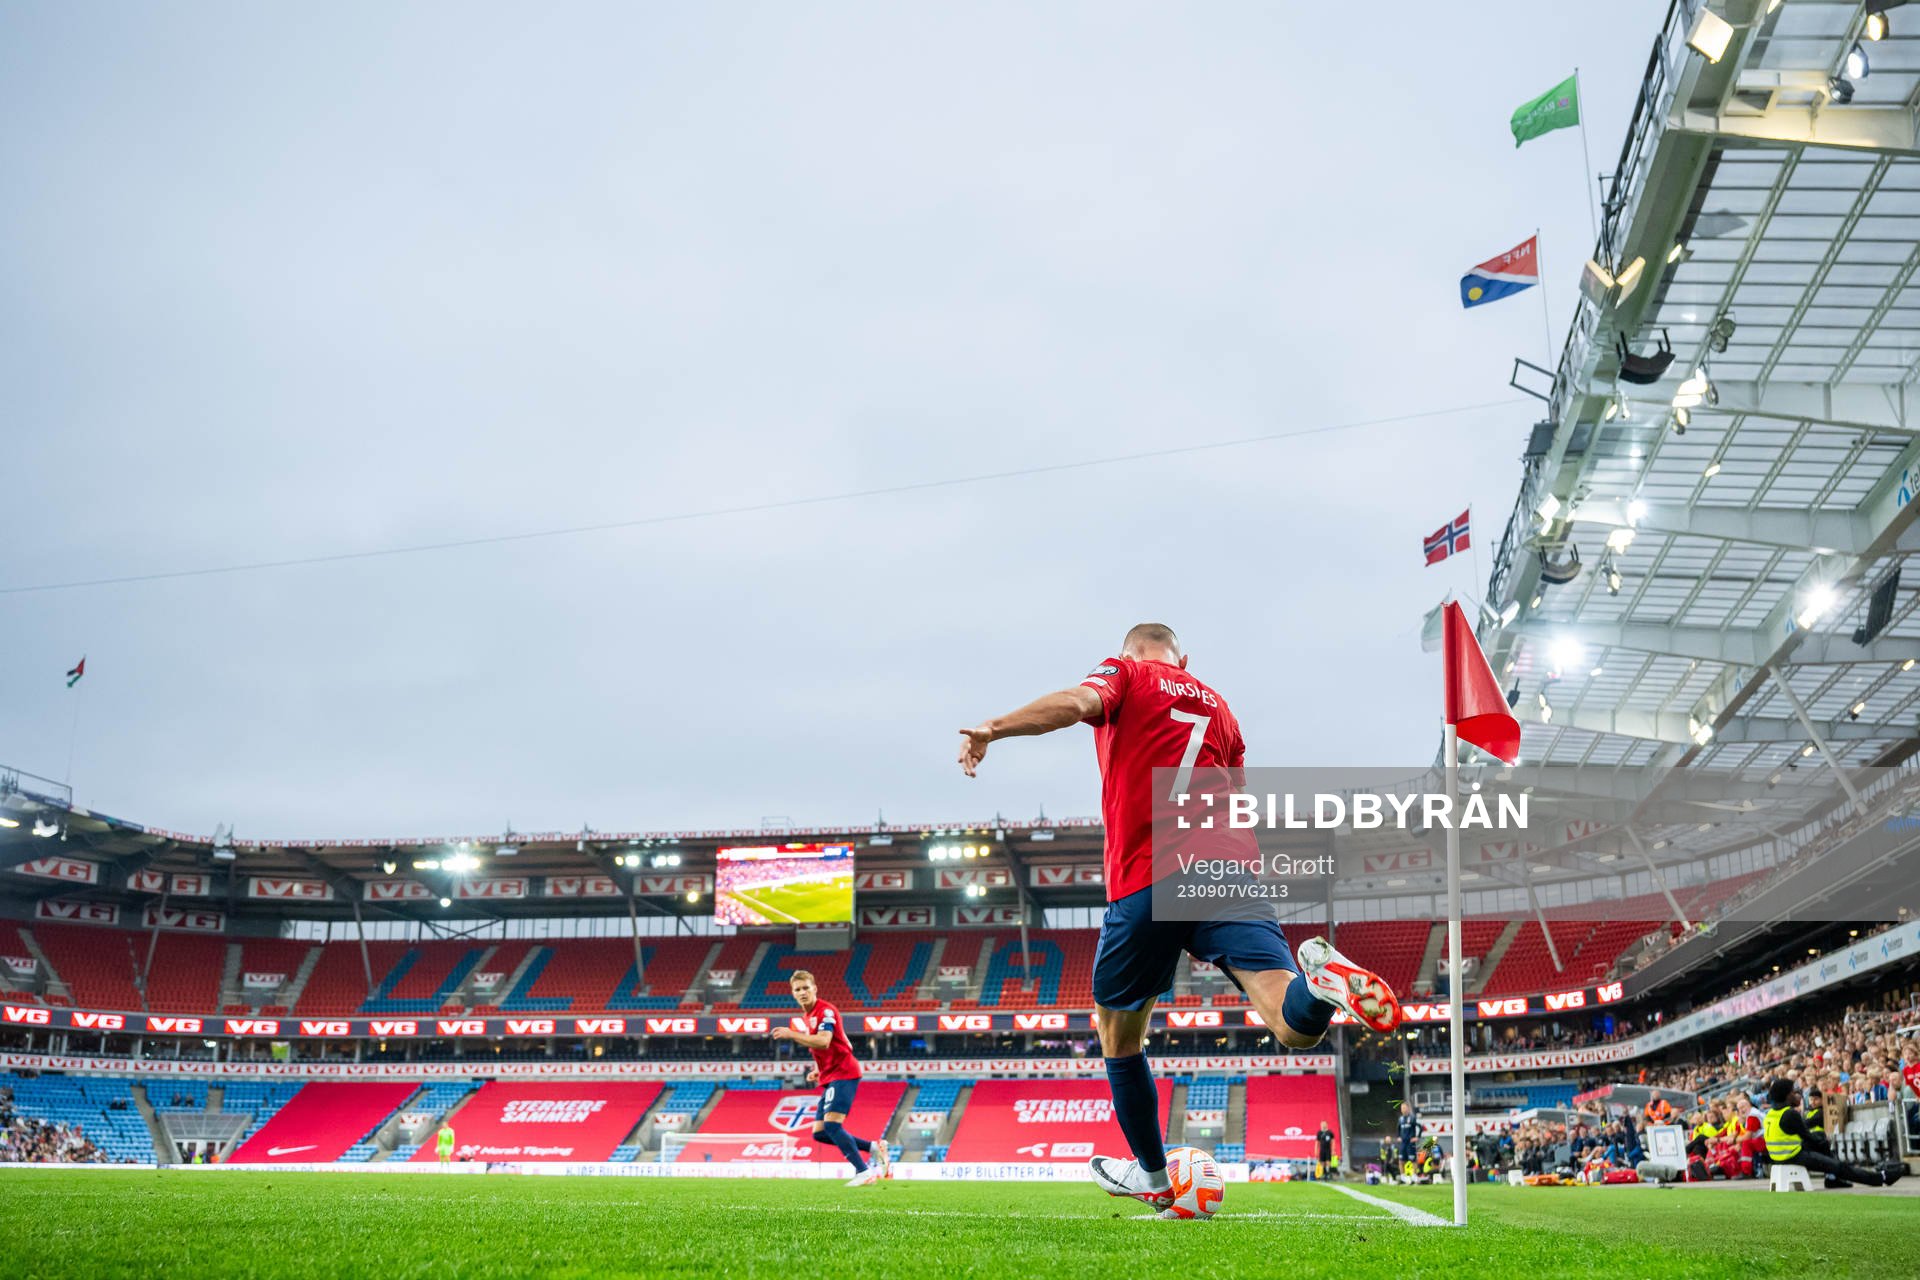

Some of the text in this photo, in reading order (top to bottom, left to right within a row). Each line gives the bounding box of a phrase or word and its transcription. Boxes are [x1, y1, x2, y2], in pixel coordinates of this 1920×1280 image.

[1168, 707, 1212, 801] 7
[1568, 820, 1607, 841] V
[1365, 849, 1431, 872] VG
[28, 859, 92, 881] VG
[1039, 868, 1104, 884] VG
[142, 871, 200, 894] VG
[940, 871, 1006, 886] VG
[258, 881, 327, 896] VG
[371, 882, 434, 897] VG
[461, 881, 522, 896] VG
[549, 880, 616, 894] VG
[642, 878, 704, 893] VG
[46, 902, 112, 923] VG
[863, 908, 931, 924] VG
[956, 906, 1023, 923] VG
[152, 910, 221, 929] VG
[1597, 984, 1623, 1003] VG
[1545, 991, 1586, 1011] VG
[1403, 1004, 1451, 1021] VG
[1478, 999, 1528, 1017] VG
[4, 1006, 50, 1024] VG
[73, 1012, 124, 1029] VG
[1015, 1014, 1067, 1029] VG
[1168, 1012, 1222, 1027] VG
[149, 1017, 202, 1033] VG
[227, 1020, 278, 1035] VG
[302, 1022, 350, 1036] VG
[371, 1021, 418, 1036] VG
[439, 1021, 486, 1035] VG
[507, 1020, 554, 1034] VG
[577, 1019, 626, 1034] VG
[647, 1018, 696, 1034] VG
[718, 1017, 768, 1033] VG
[866, 1016, 917, 1031] VG
[940, 1015, 991, 1030] VG
[7, 1056, 41, 1066] VG
[49, 1058, 83, 1068] VG
[1163, 1059, 1199, 1068] VG
[1206, 1058, 1243, 1068] VG
[1250, 1057, 1287, 1067] VG
[1294, 1056, 1332, 1066] VG
[1497, 1057, 1533, 1068] VG
[1537, 1054, 1566, 1066] VG
[1570, 1052, 1594, 1064] VG
[91, 1060, 126, 1070] VG
[134, 1061, 171, 1071] VG
[179, 1063, 215, 1072] VG
[223, 1064, 258, 1074] VG
[265, 1065, 300, 1074] VG
[306, 1065, 340, 1074] VG
[347, 1065, 378, 1074] VG
[385, 1065, 416, 1074] VG
[423, 1065, 455, 1074] VG
[462, 1065, 493, 1074] VG
[501, 1065, 532, 1074] VG
[540, 1064, 572, 1073] VG
[580, 1064, 612, 1073] VG
[620, 1064, 652, 1073] VG
[659, 1064, 692, 1073] VG
[700, 1063, 733, 1073] VG
[740, 1063, 773, 1073] VG
[864, 1062, 898, 1072] VG
[906, 1062, 940, 1071] VG
[948, 1061, 983, 1071] VG
[990, 1060, 1026, 1070] VG
[1033, 1060, 1068, 1070] VG
[502, 1100, 607, 1112] STERKERE
[500, 1111, 591, 1123] SAMMEN
[1017, 1110, 1112, 1123] SAMMEN
[479, 1147, 574, 1156] Norsk Tipping
[941, 1166, 972, 1178] KJØP
[976, 1166, 1034, 1178] BILLETTER
